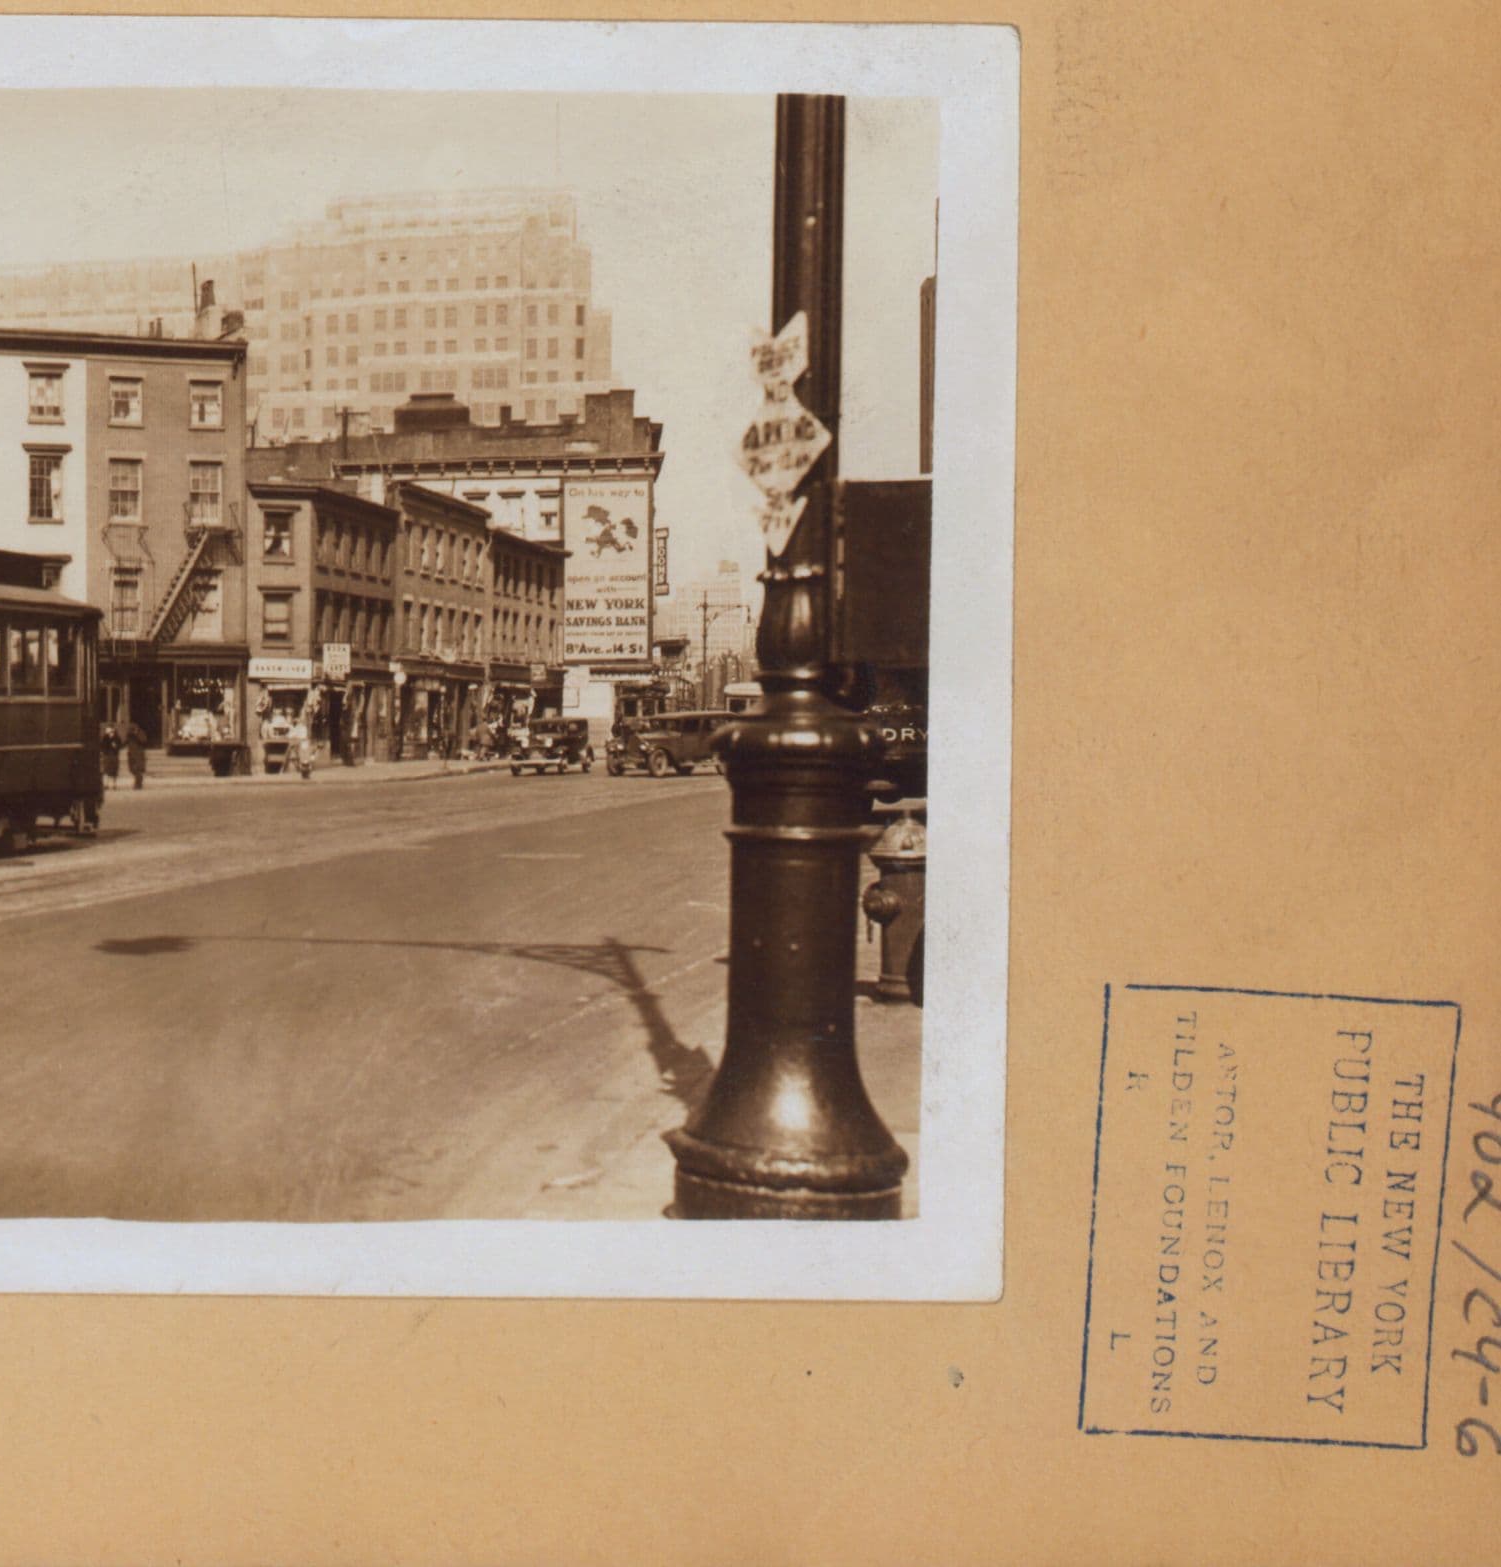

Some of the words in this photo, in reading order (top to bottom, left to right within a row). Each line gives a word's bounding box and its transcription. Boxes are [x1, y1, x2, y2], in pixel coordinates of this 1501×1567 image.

[565, 616, 612, 627] SAVINGS
[615, 615, 647, 627] BANK
[566, 575, 591, 585] open
[609, 574, 647, 583] account
[566, 598, 598, 611] NEW
[604, 597, 645, 610] YORK
[1167, 1011, 1197, 1142] TILDEN
[1323, 1029, 1372, 1185] PUBLIC
[1388, 1074, 1425, 1151] THE
[1199, 1175, 1230, 1292] LENOX
[1379, 1170, 1418, 1261] NEW
[1149, 1163, 1186, 1413] FOUNDATIONS
[1306, 1212, 1359, 1413] LIBRARY
[1370, 1280, 1408, 1375] YORK
[1195, 1312, 1218, 1386] AND
